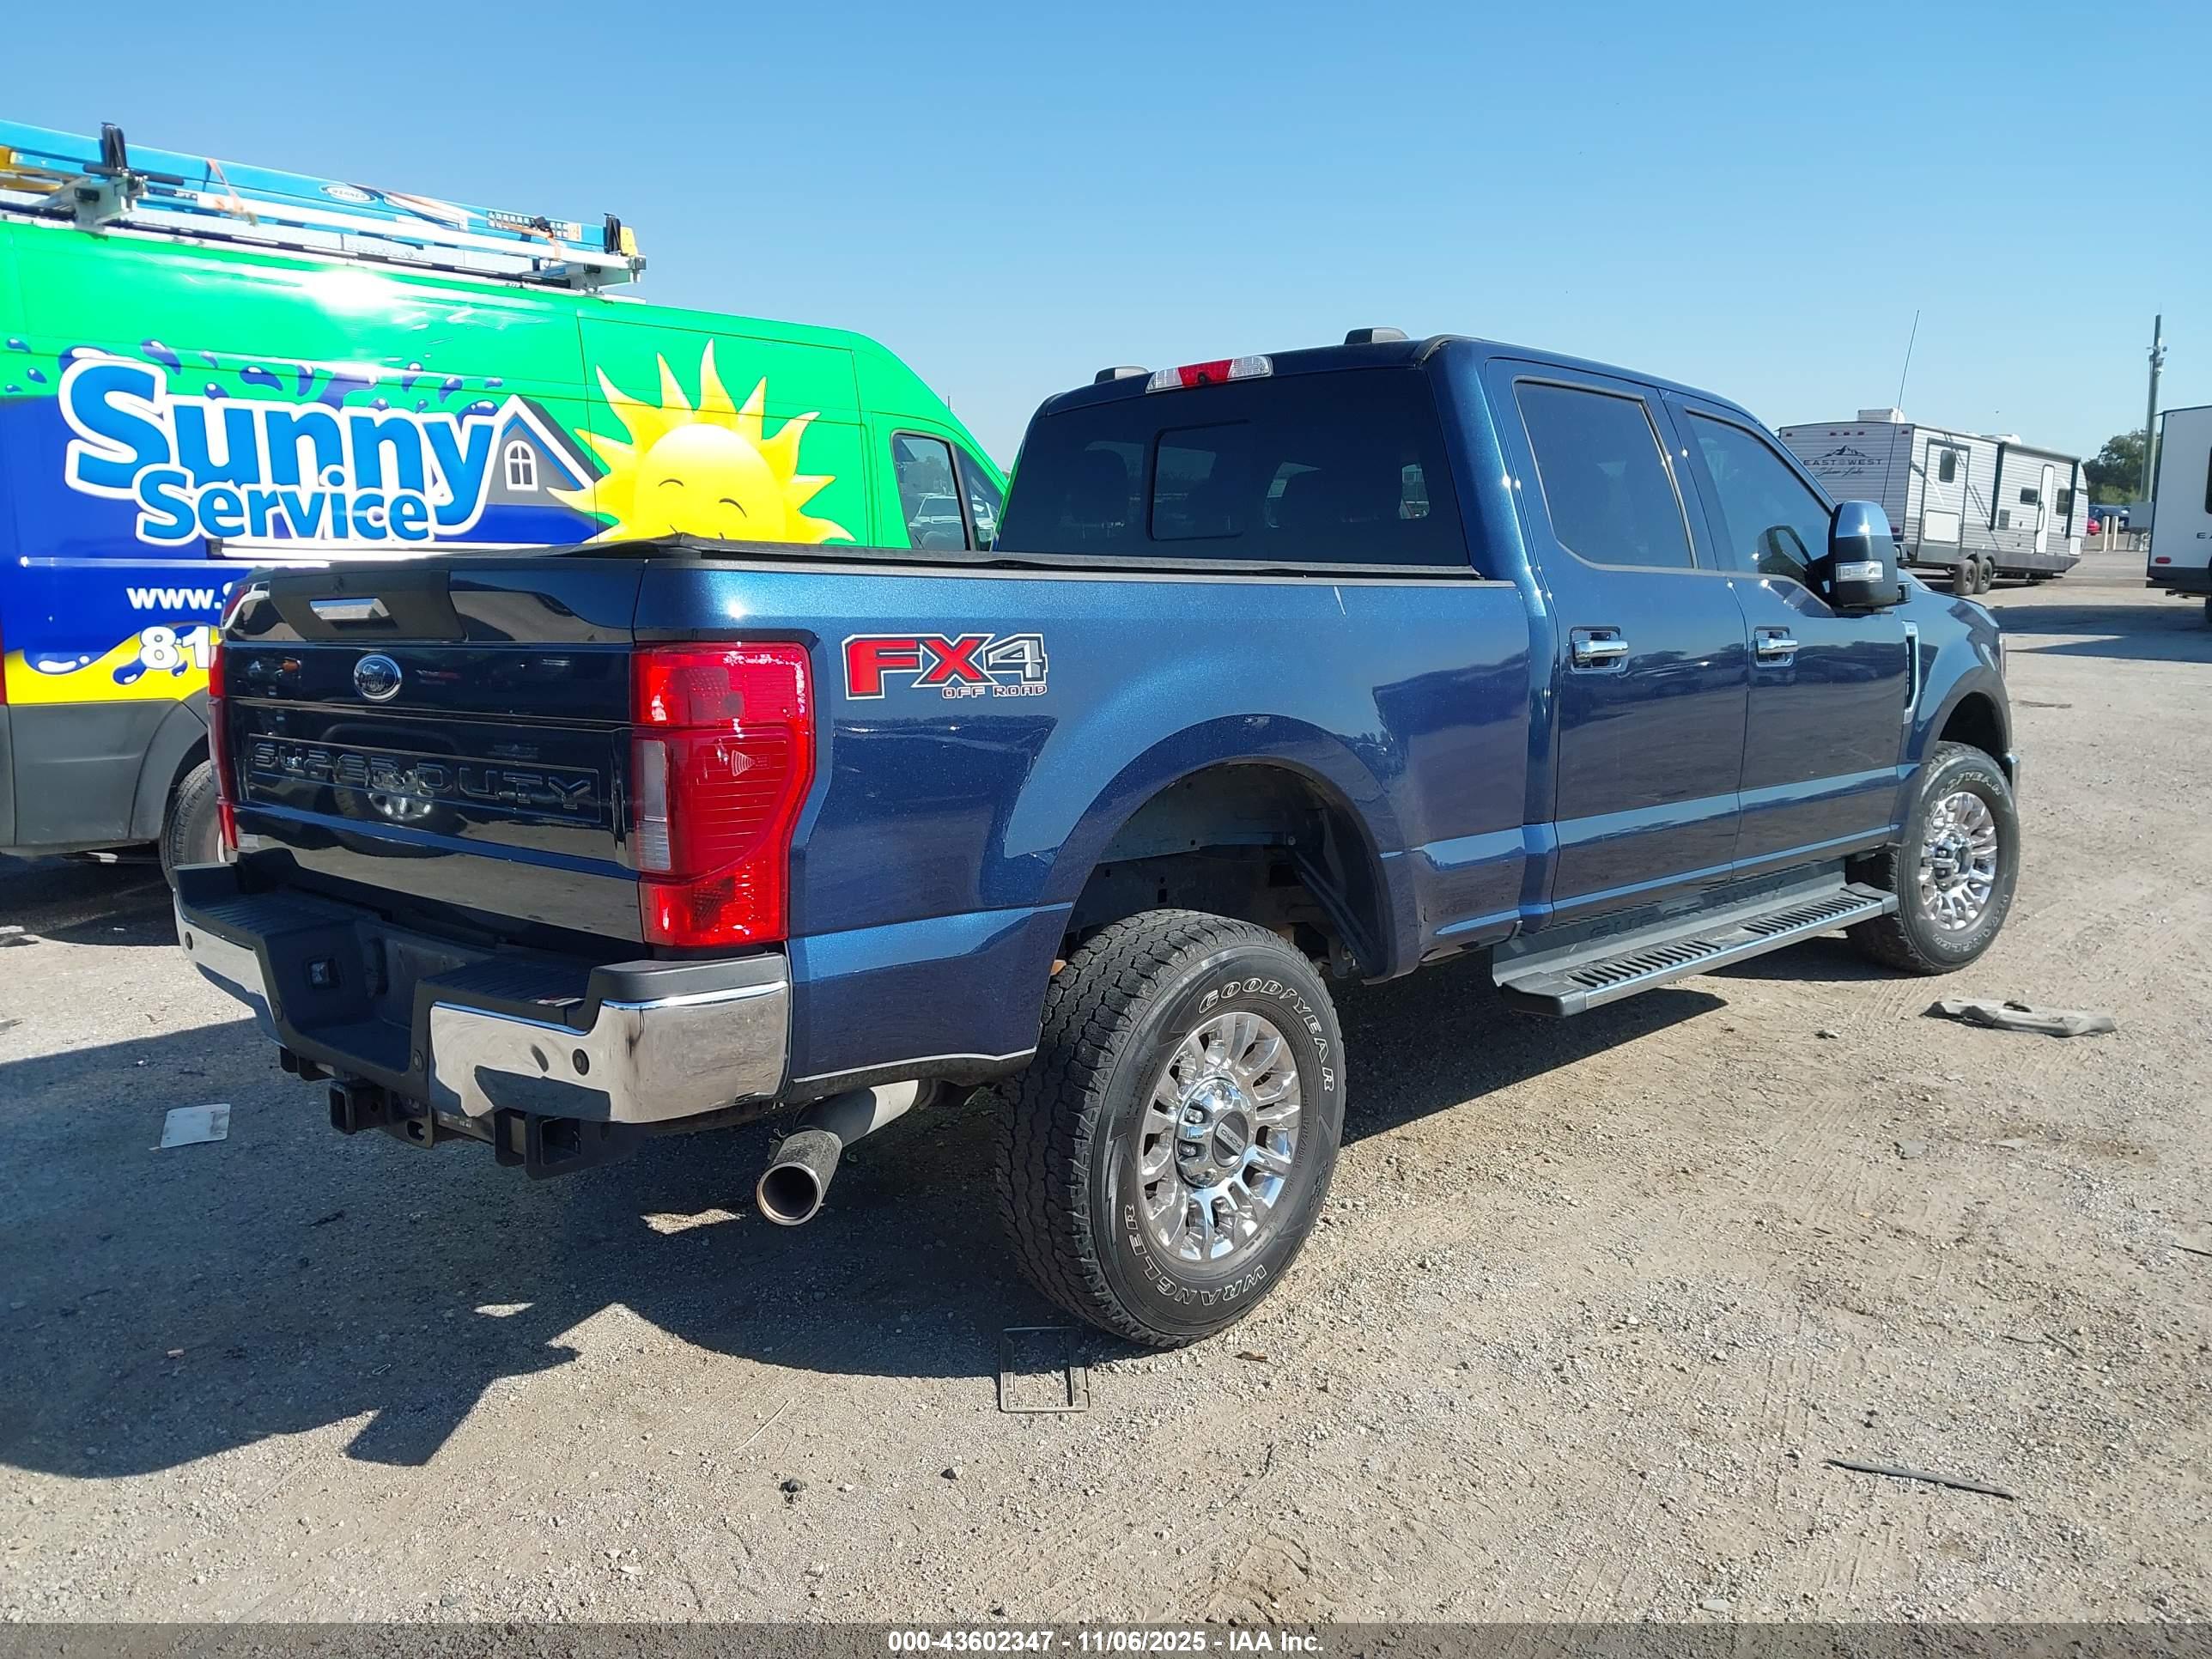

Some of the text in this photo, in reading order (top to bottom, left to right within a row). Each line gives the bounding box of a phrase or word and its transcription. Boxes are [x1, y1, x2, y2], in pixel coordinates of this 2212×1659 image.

[64, 360, 493, 526] Sunny
[136, 468, 432, 543] Service
[842, 633, 1048, 700] FX4
[942, 684, 1048, 699] OFF ROAD
[253, 741, 592, 810] SUPER DUTY
[1199, 977, 1334, 1092] GOODYEAR
[1124, 1204, 1268, 1306] WRANGLER
